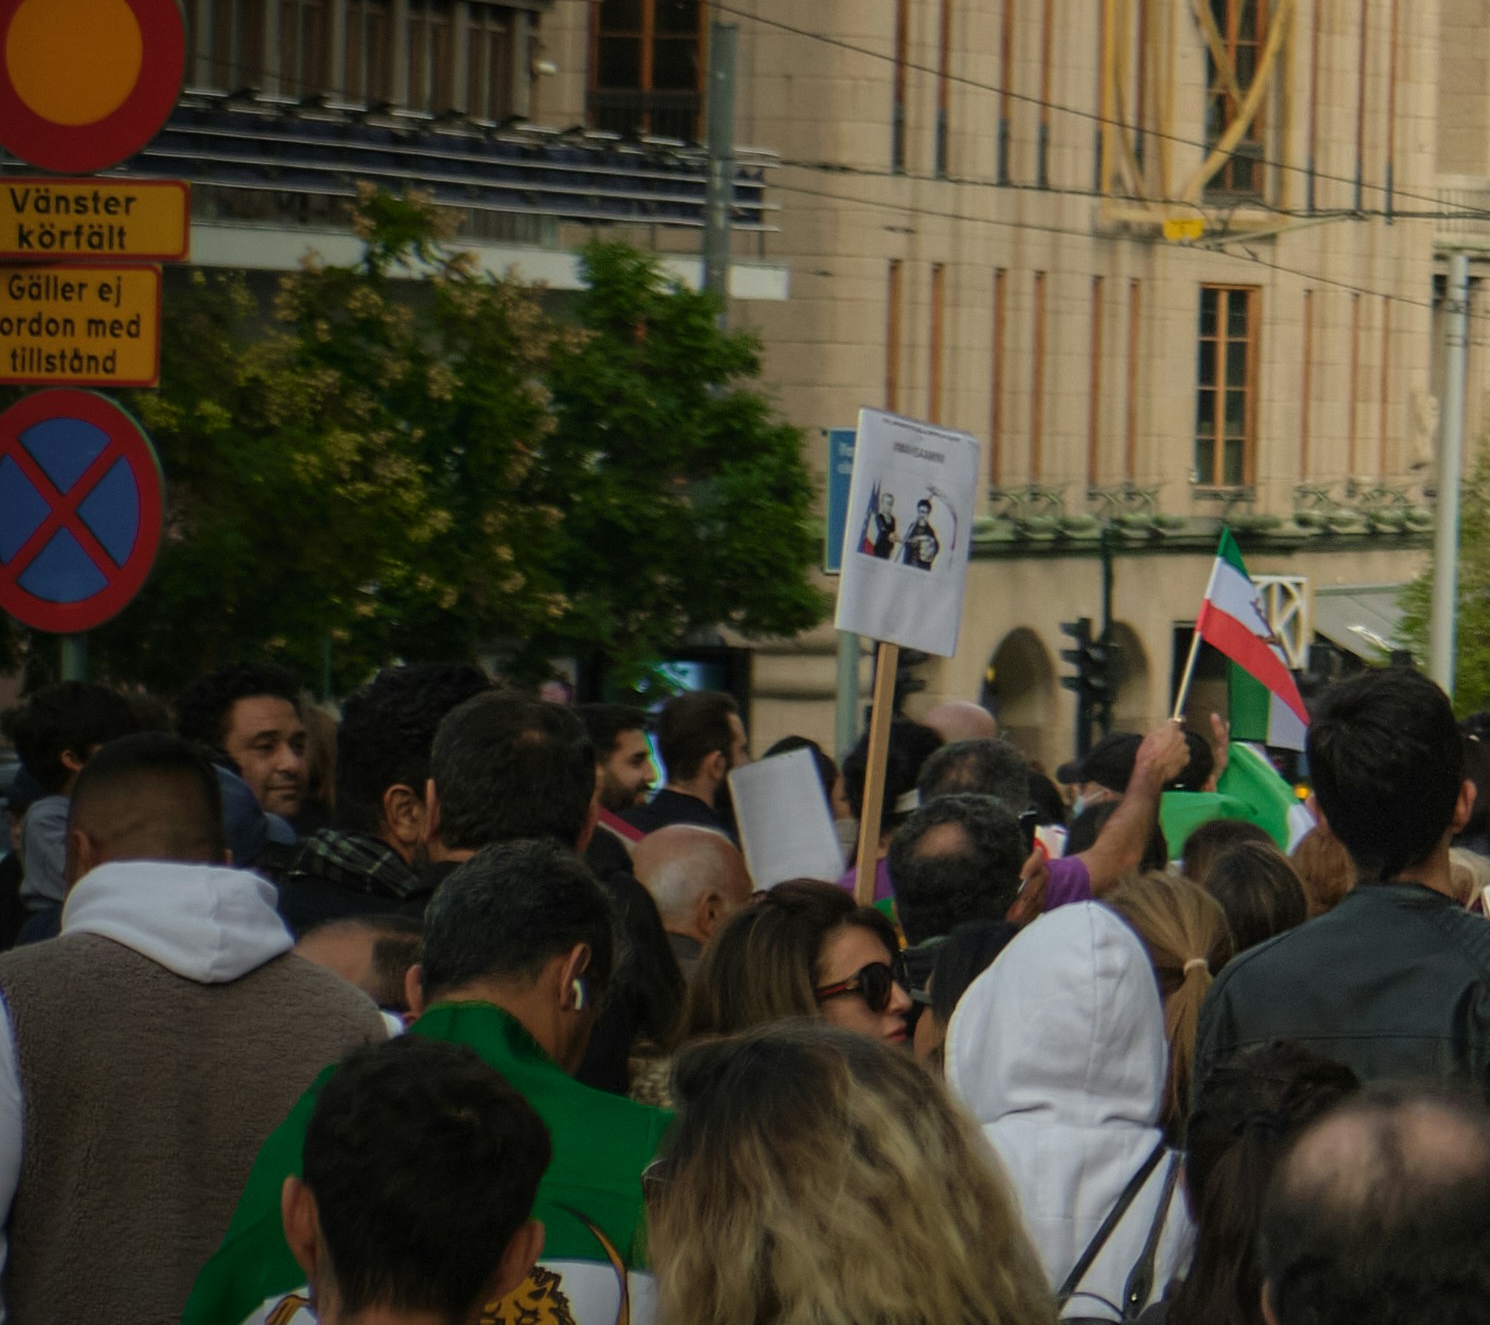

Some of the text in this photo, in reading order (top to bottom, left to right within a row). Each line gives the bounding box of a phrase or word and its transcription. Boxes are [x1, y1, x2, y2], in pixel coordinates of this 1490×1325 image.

[9, 187, 137, 215] Vänster
[17, 223, 127, 250] körfält
[8, 274, 122, 308] Gäller ej
[87, 314, 141, 339] med
[11, 346, 117, 374] tillstånd
